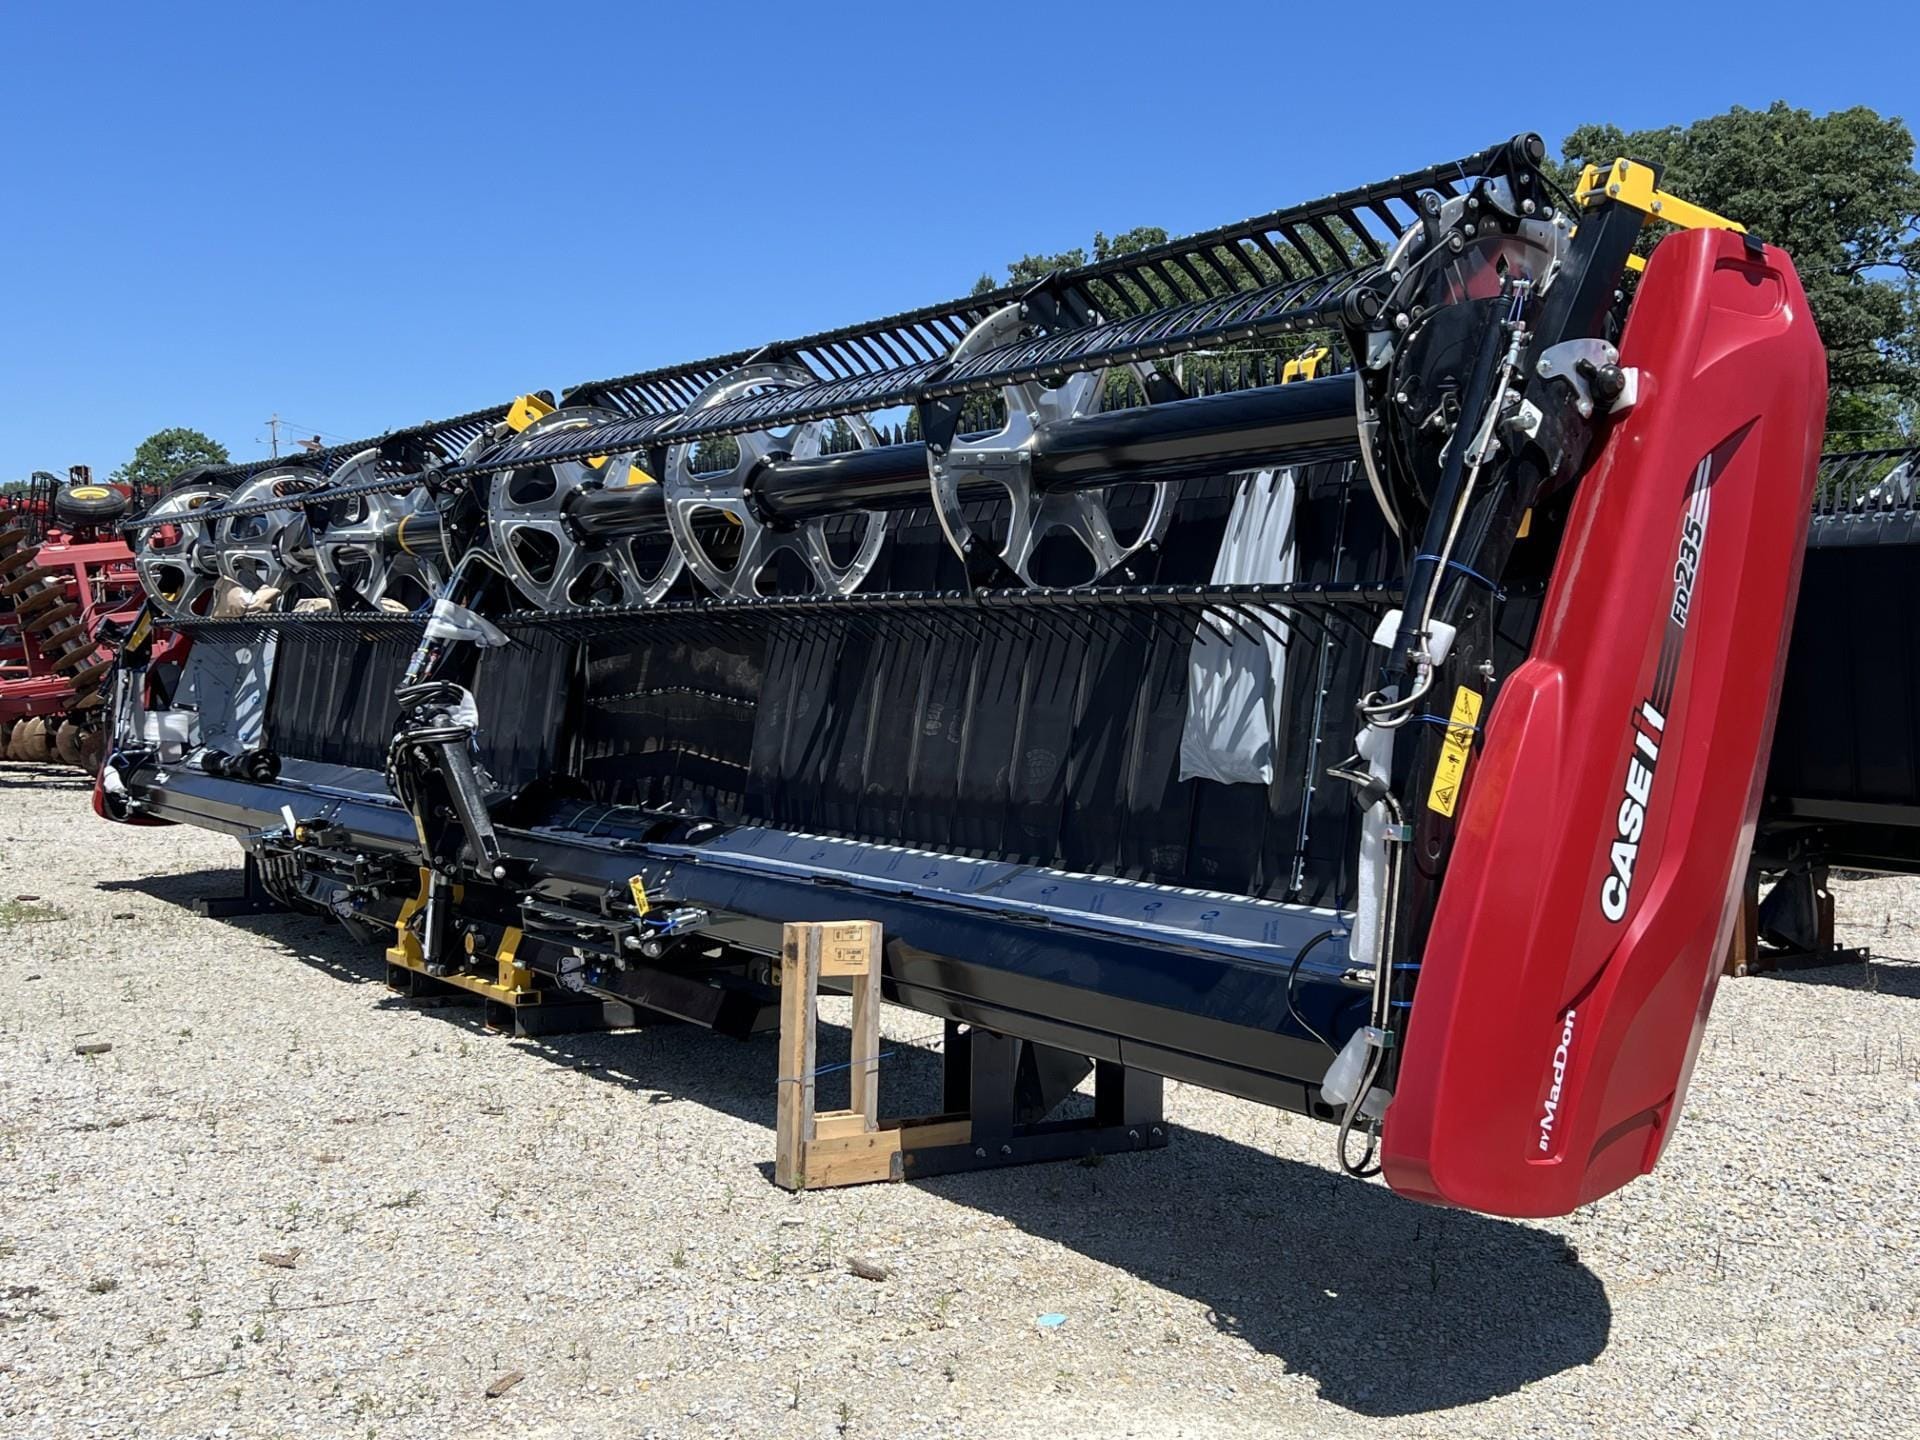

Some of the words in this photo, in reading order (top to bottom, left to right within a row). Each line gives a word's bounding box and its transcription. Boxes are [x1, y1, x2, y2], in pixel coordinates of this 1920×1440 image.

[1671, 512, 1703, 628] FD235
[1540, 1009, 1576, 1131] MacDon
[1539, 1130, 1550, 1152] BY
